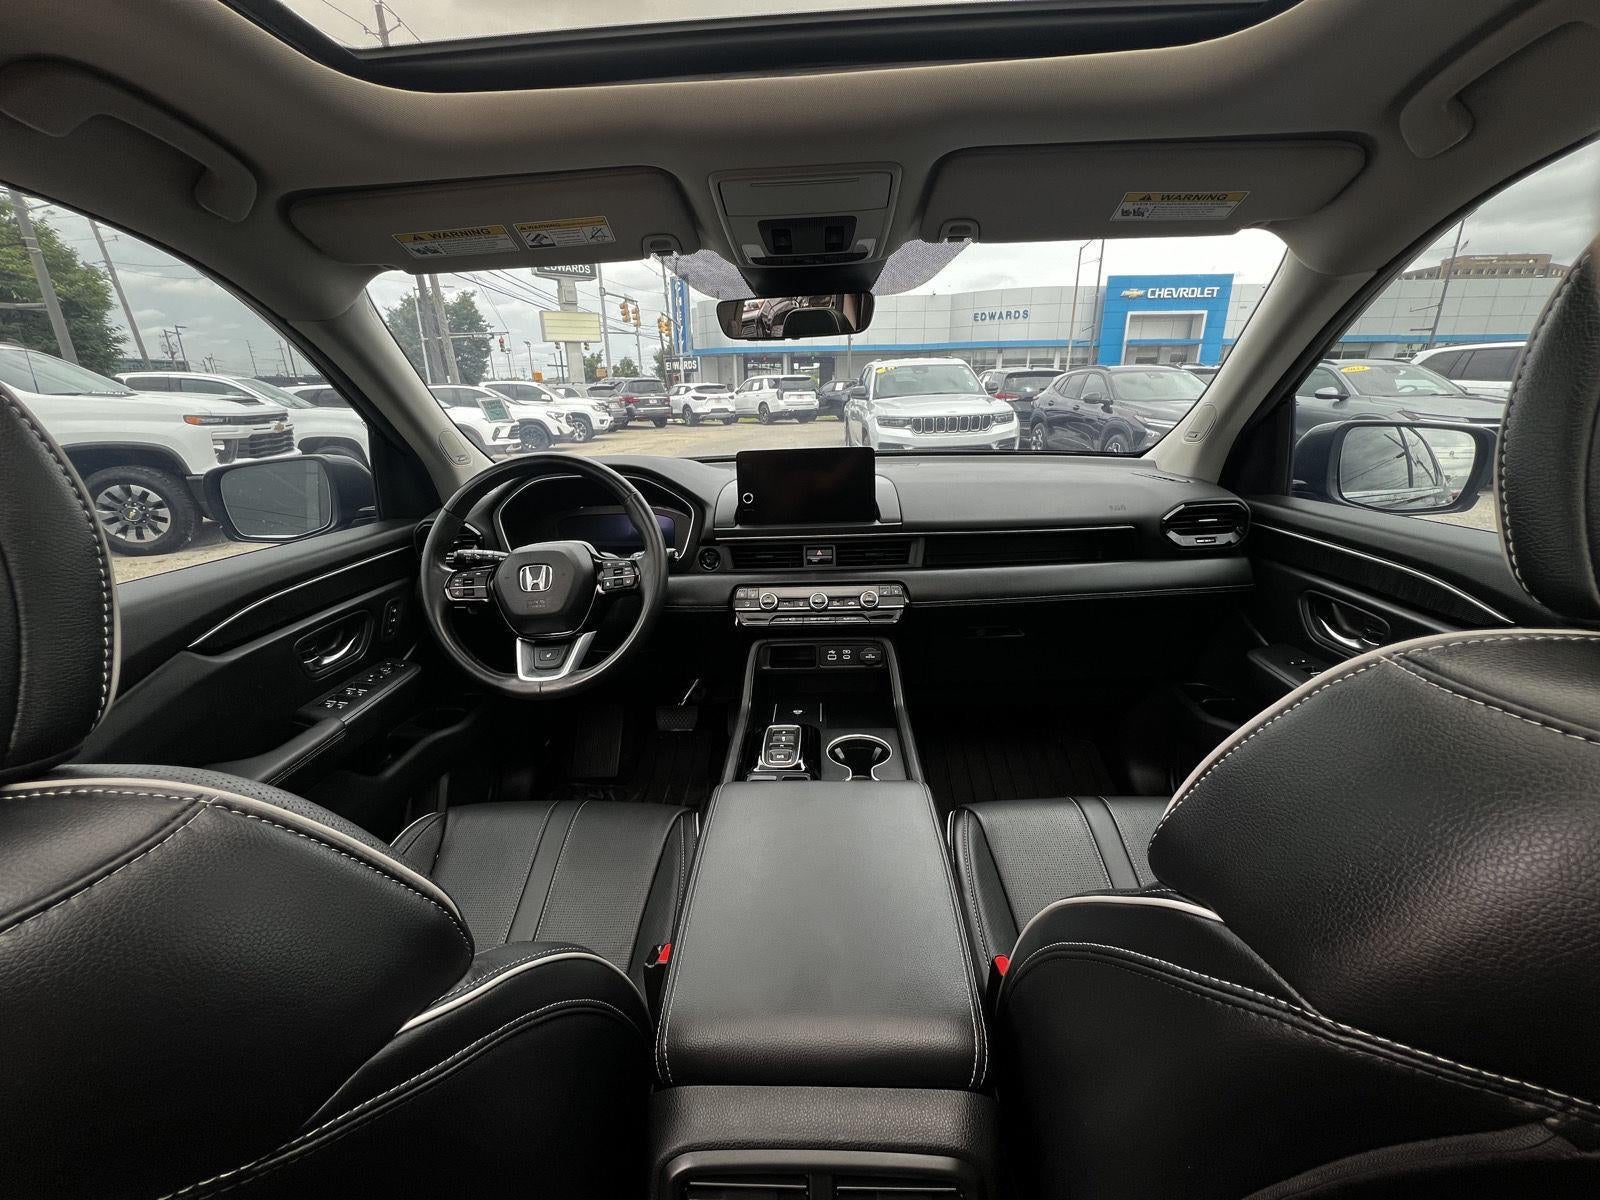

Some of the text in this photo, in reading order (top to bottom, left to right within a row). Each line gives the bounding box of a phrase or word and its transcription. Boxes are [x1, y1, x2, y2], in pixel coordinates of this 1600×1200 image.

[1160, 193, 1229, 201] WARNING
[429, 228, 491, 240] WARNING
[1147, 286, 1220, 299] CHEVROLET
[973, 309, 1029, 322] EDWARDS
[666, 359, 698, 371] EWRDS
